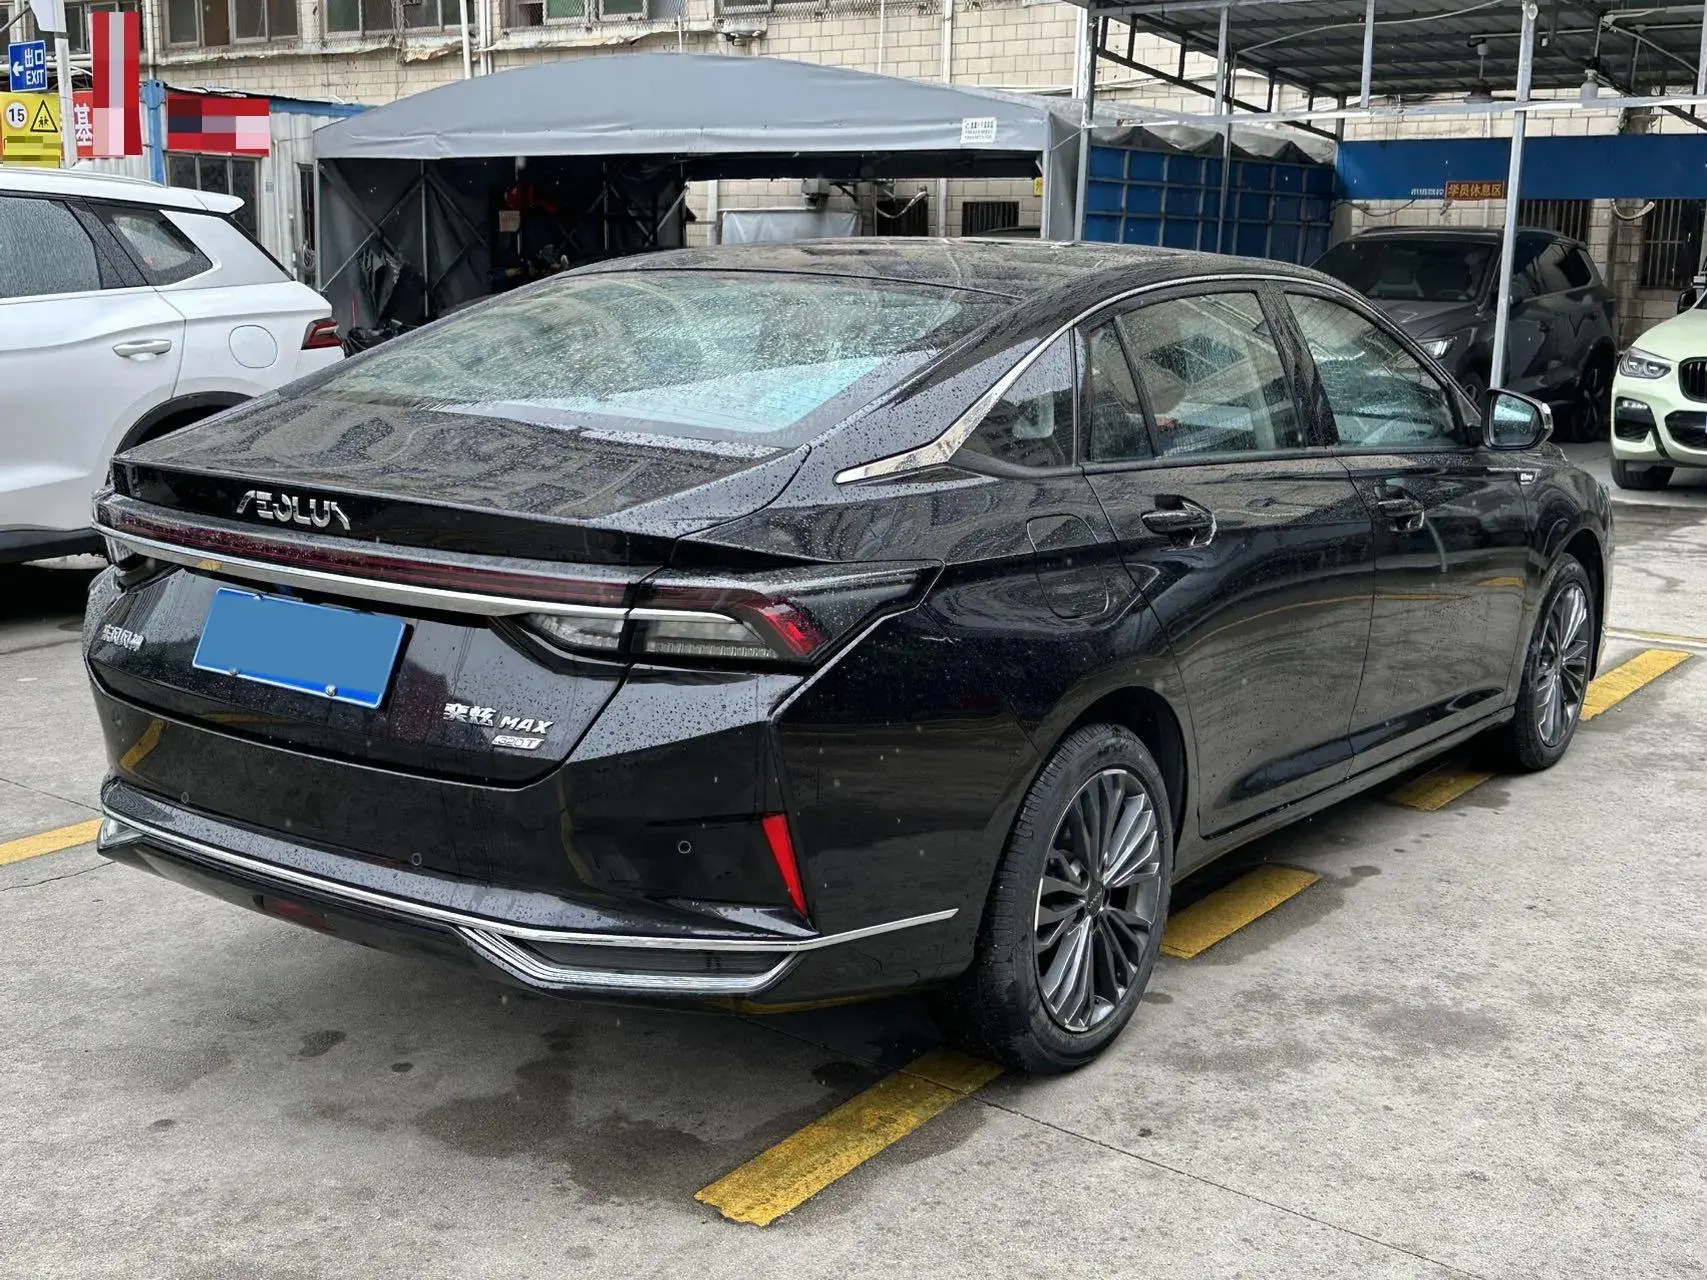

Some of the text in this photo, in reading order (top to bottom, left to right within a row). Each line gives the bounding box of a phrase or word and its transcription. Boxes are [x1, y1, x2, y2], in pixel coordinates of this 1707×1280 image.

[24, 48, 44, 68] 出口
[26, 69, 45, 86] EXIT
[8, 108, 25, 122] 15
[74, 102, 93, 147] 基
[1448, 183, 1502, 197] 学员休息区
[442, 702, 555, 735] 奕炫 MAX
